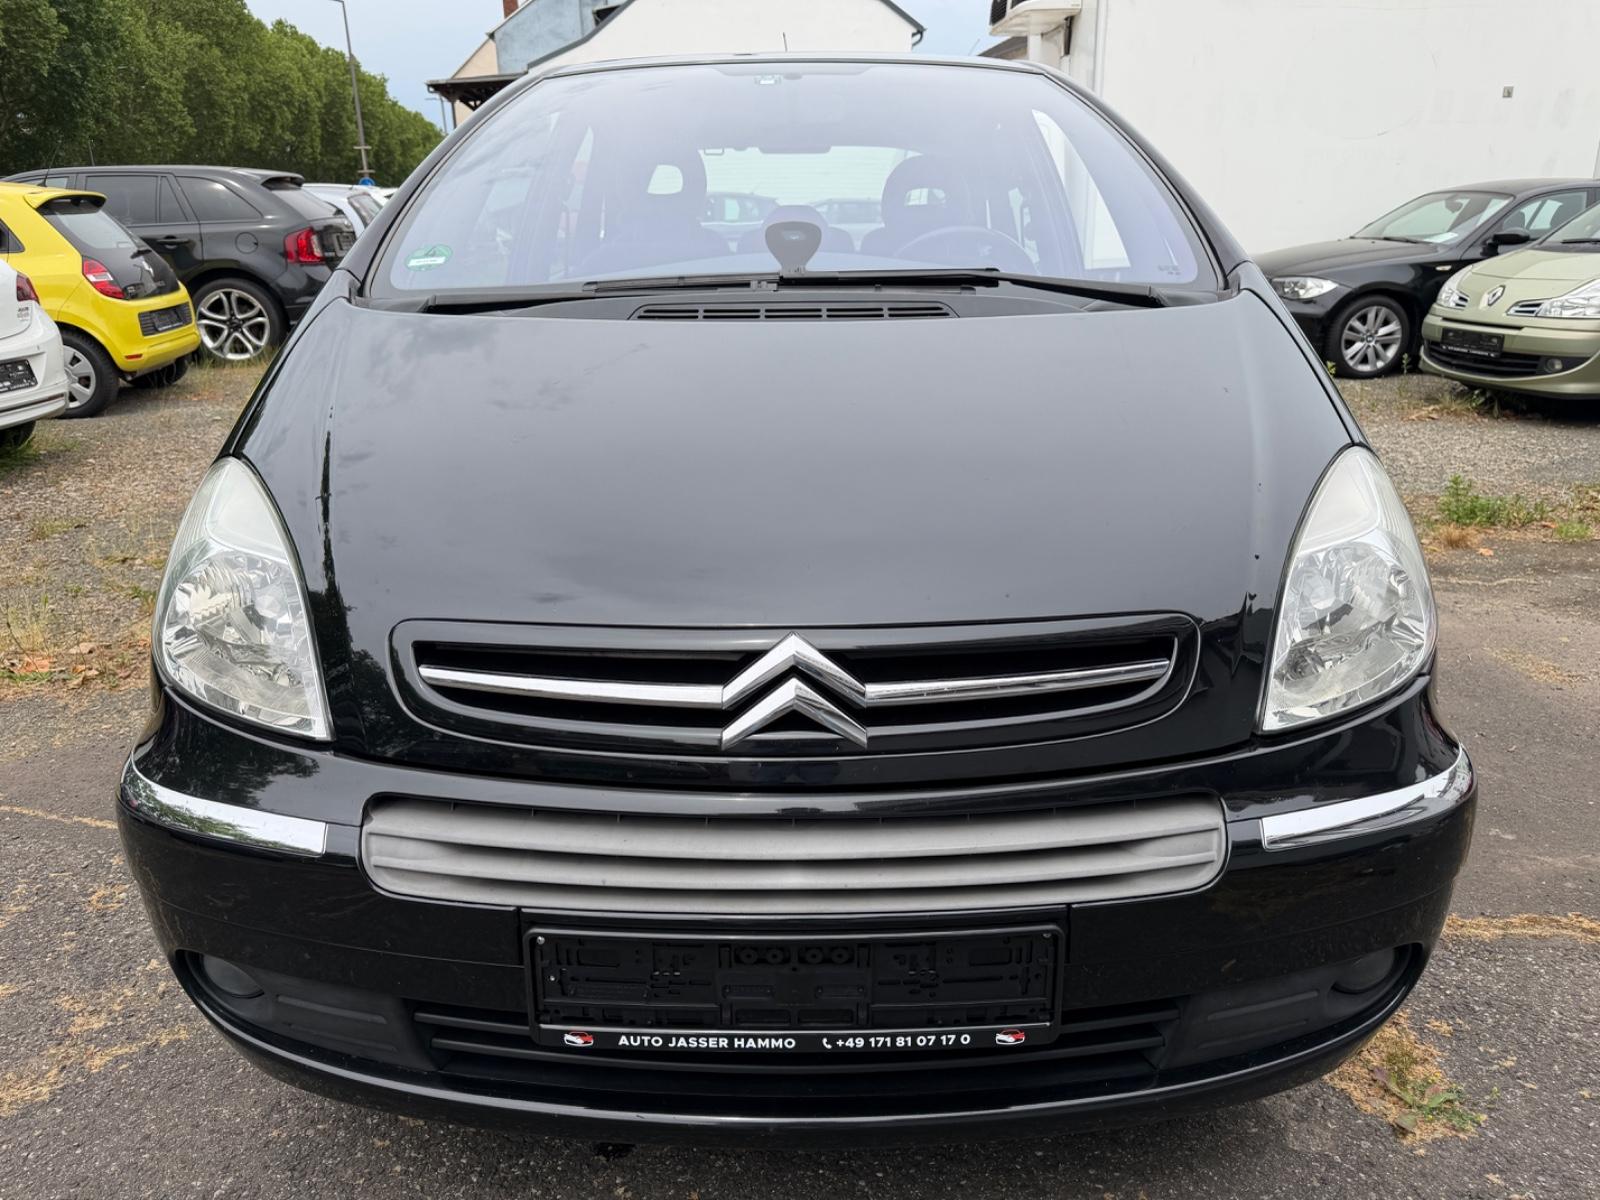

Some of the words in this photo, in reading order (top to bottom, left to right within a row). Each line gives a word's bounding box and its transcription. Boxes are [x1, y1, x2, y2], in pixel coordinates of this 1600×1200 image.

[617, 1034, 663, 1048] AUTO
[667, 1036, 729, 1049] JASSER
[733, 1037, 796, 1049] HAMMO
[835, 1037, 865, 1049] +49
[868, 1036, 892, 1049] 171
[895, 1035, 912, 1048] 81
[916, 1035, 937, 1047] 07
[940, 1034, 957, 1046] 17
[959, 1033, 971, 1045] 0
